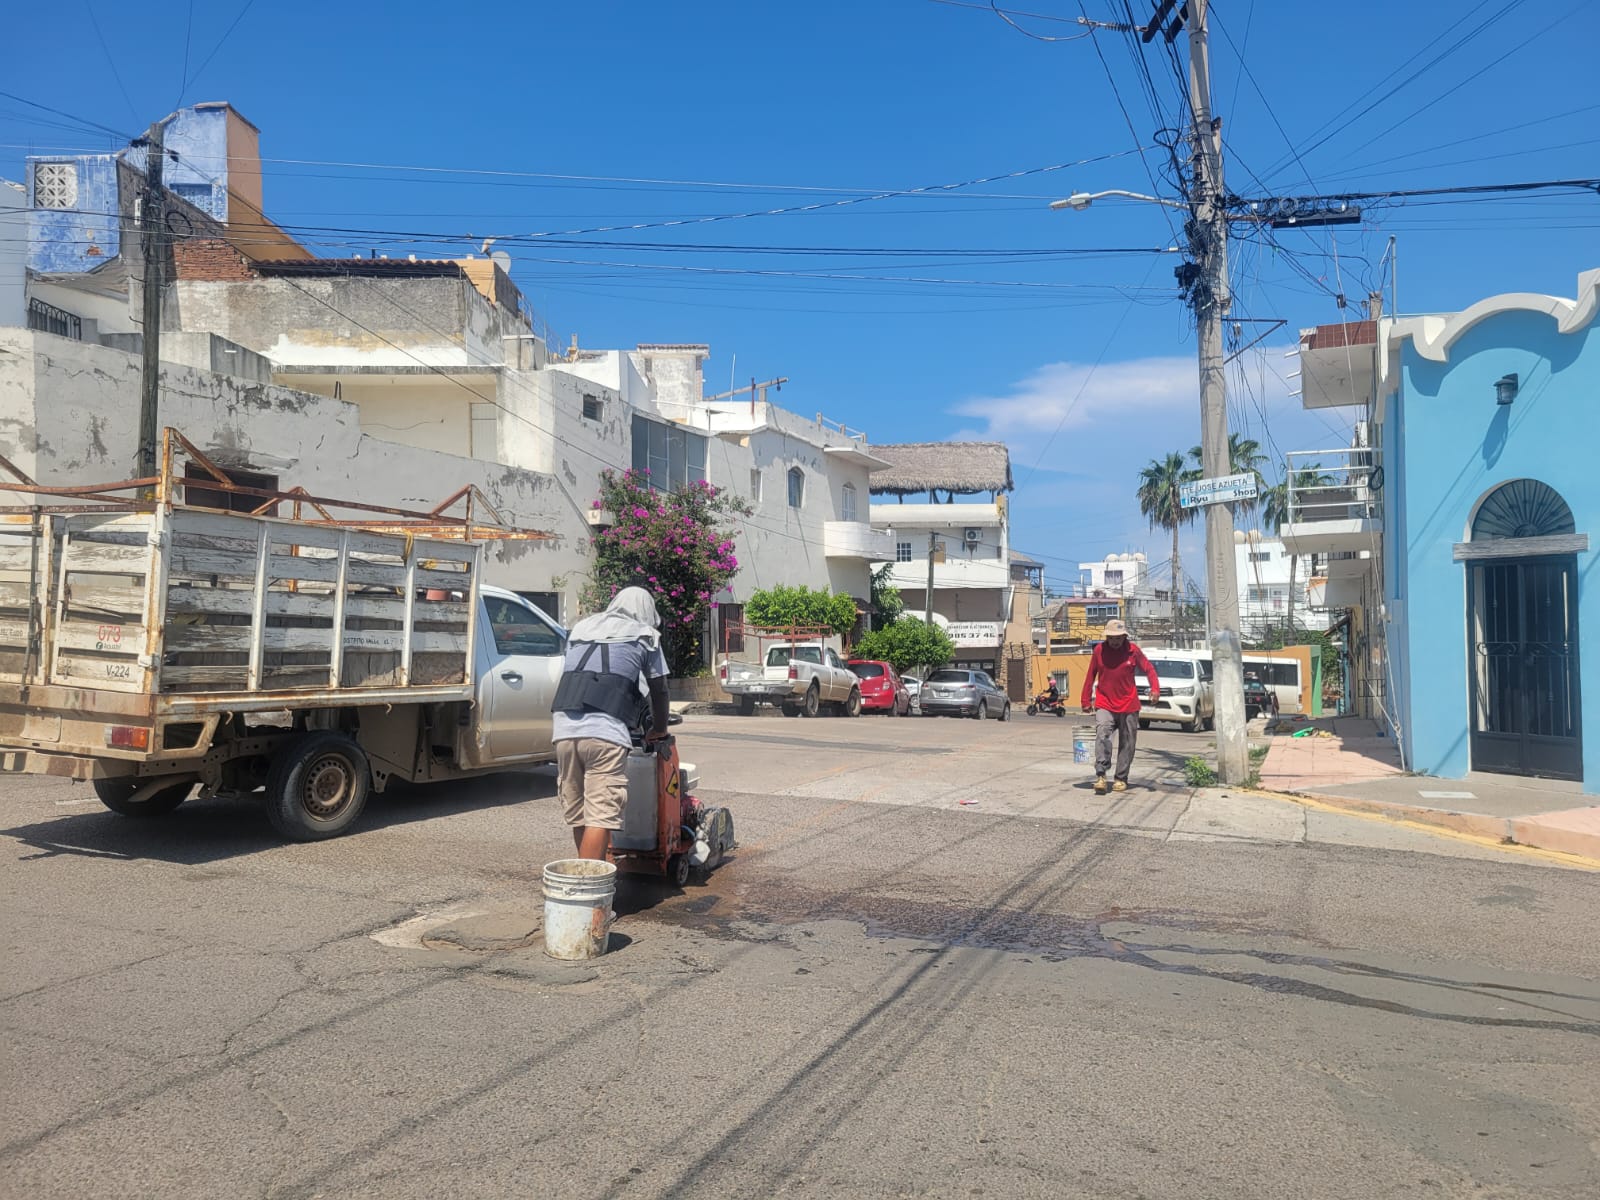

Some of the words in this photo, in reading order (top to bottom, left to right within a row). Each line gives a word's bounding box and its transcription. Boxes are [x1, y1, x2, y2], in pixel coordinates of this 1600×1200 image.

[1219, 478, 1248, 488] AZUETA
[1190, 496, 1208, 504] Ryu
[1233, 489, 1256, 497] Shop
[106, 665, 130, 678] V-224
